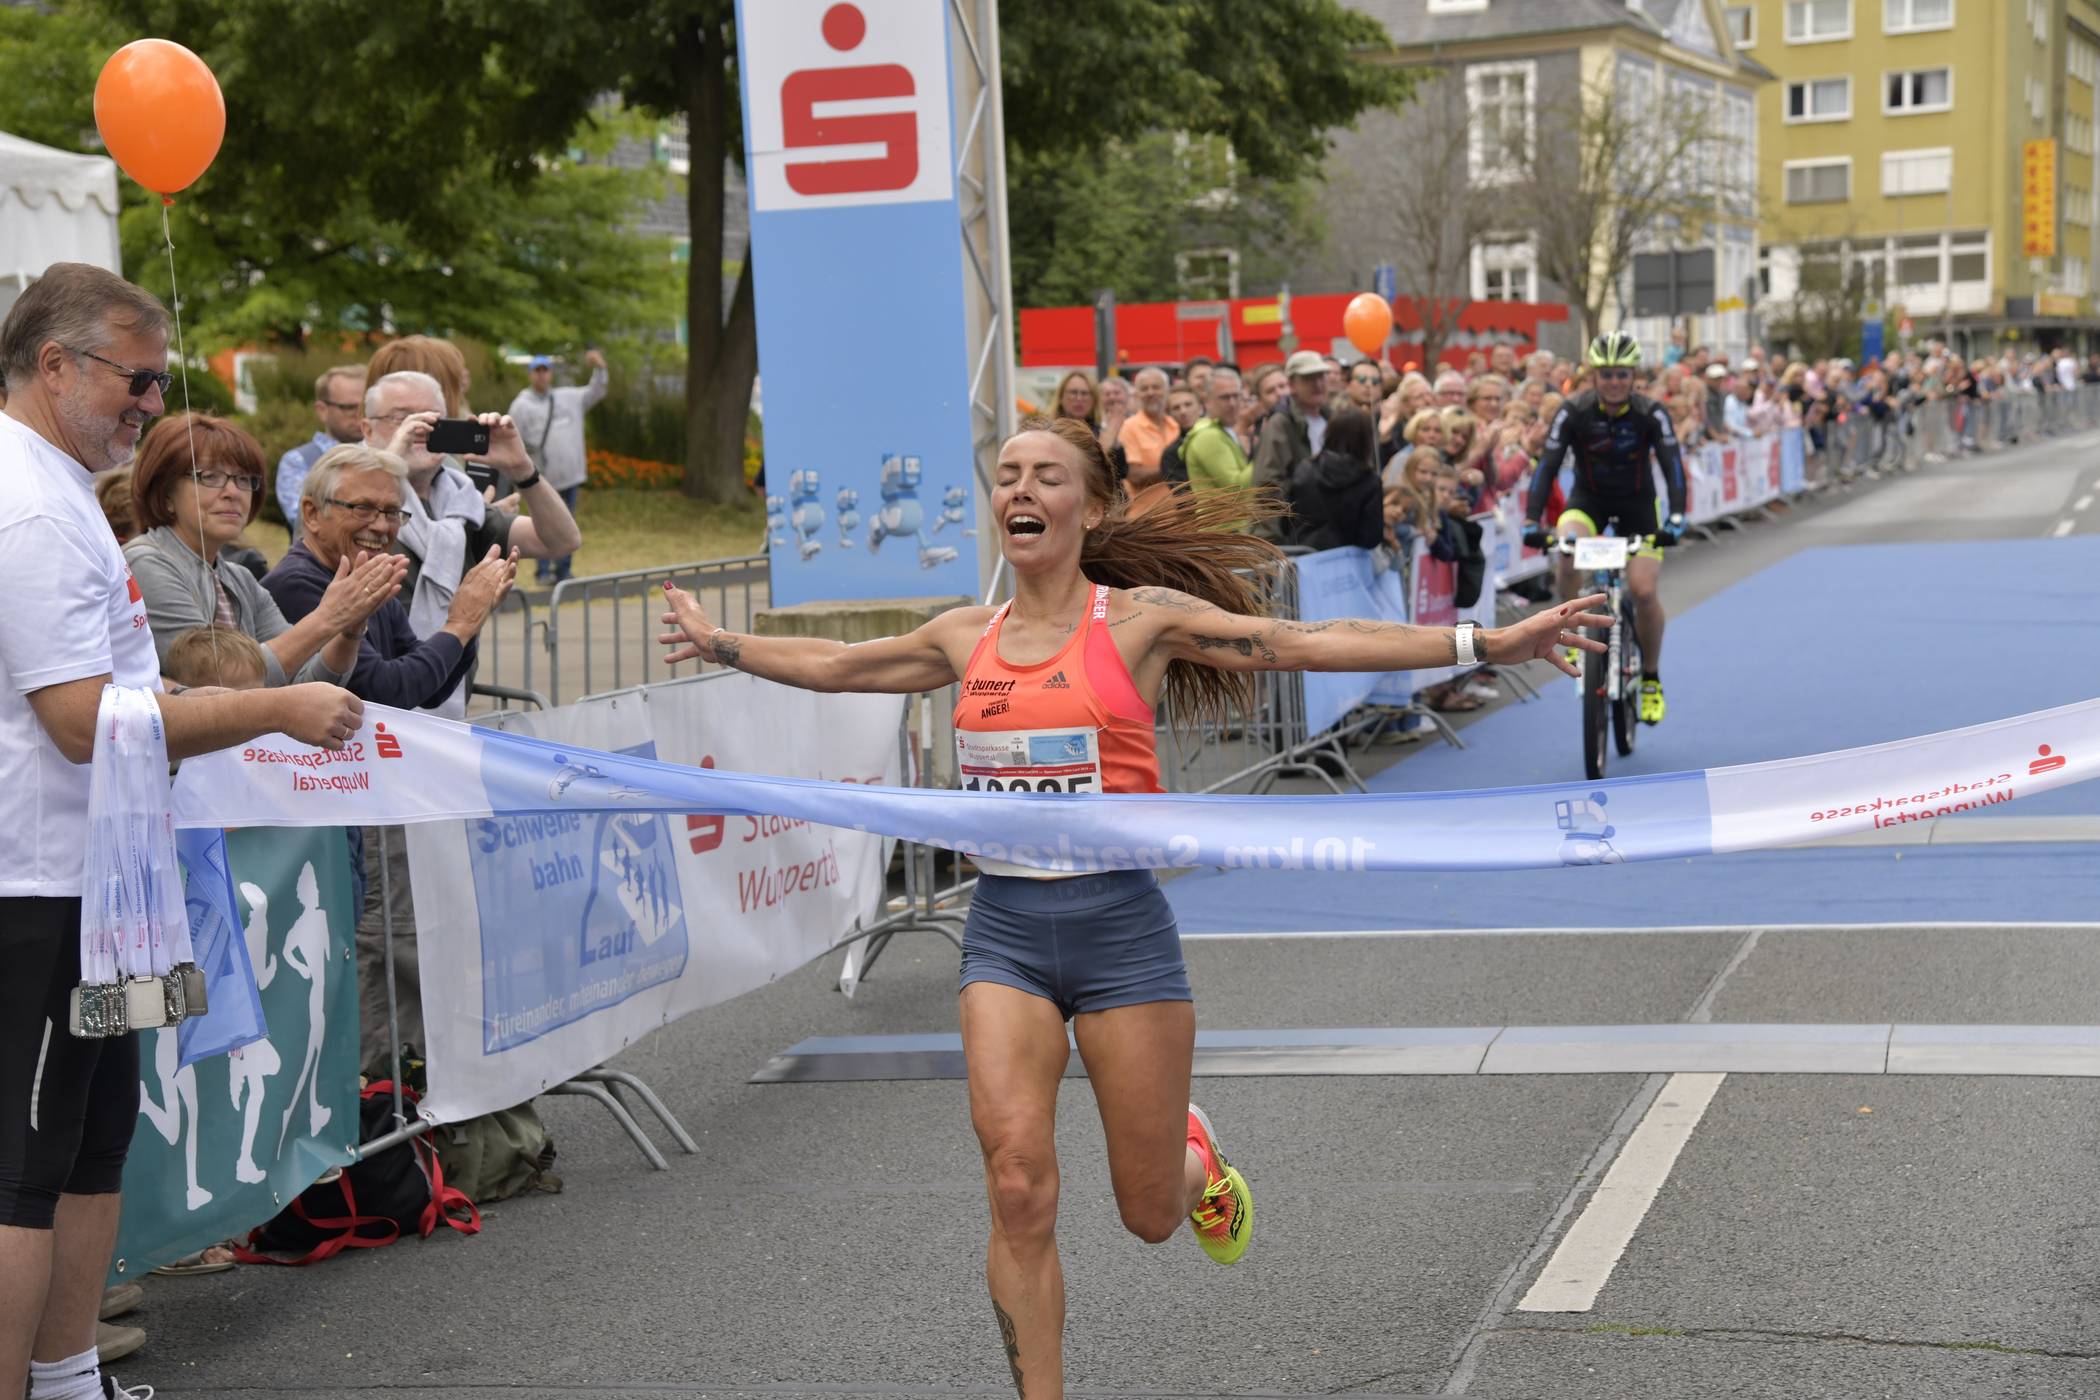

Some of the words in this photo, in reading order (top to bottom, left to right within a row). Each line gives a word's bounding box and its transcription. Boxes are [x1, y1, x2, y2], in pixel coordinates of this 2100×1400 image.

[1042, 682, 1070, 690] adidas
[981, 702, 1011, 719] ANGER!
[528, 850, 585, 891] bahn
